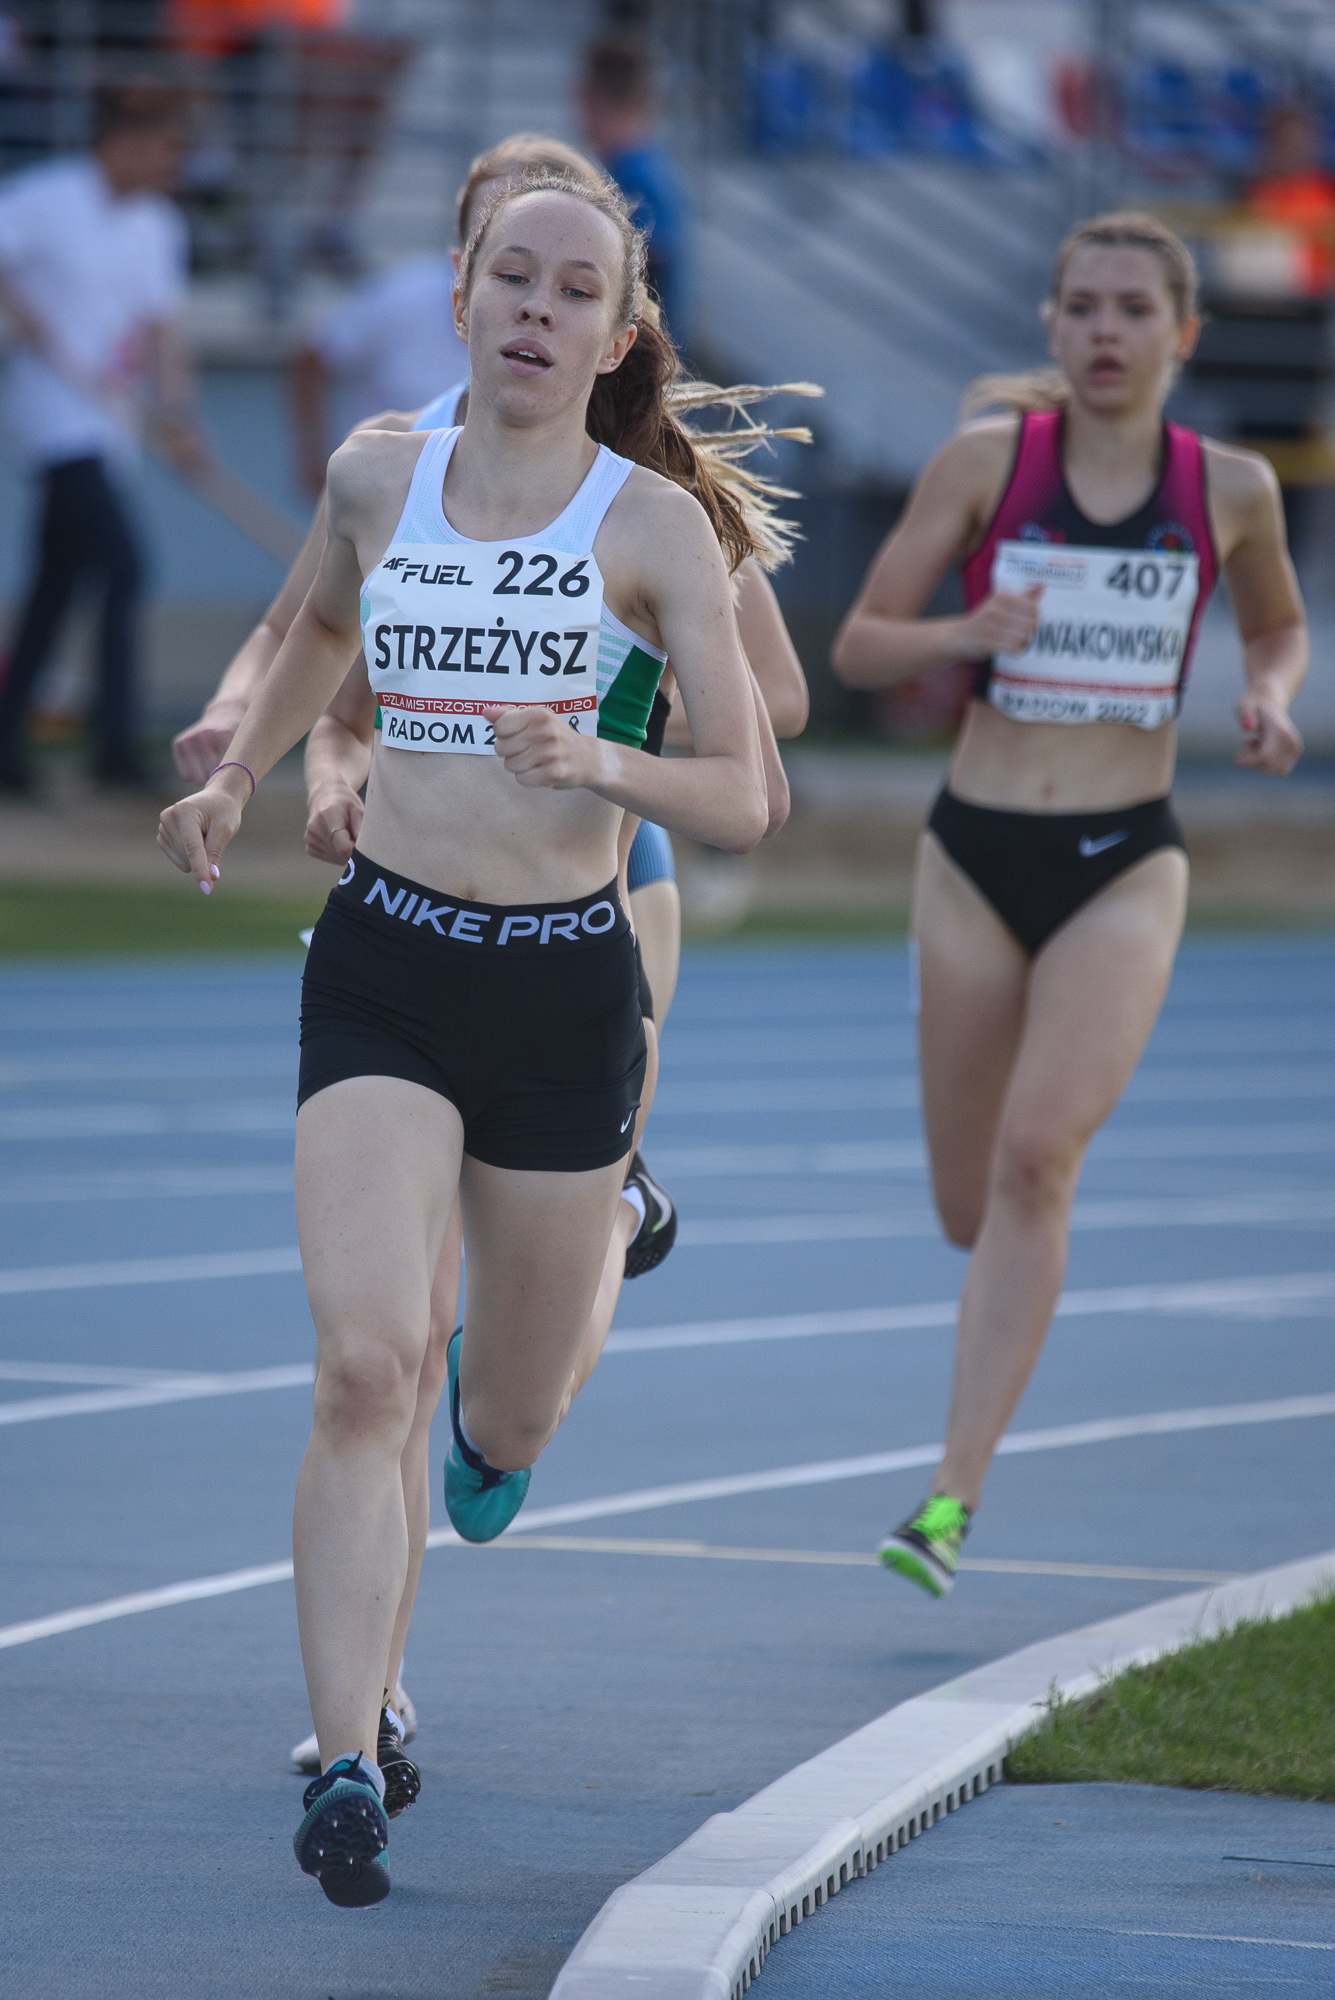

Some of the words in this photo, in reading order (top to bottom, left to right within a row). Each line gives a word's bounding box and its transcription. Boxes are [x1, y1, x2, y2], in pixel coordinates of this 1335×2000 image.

[401, 564, 474, 586] FUEL
[493, 550, 590, 598] 226
[1106, 560, 1187, 600] 407
[374, 616, 589, 676] STRZEŻYSZ
[1033, 621, 1183, 665] WAKOWSKA
[382, 694, 405, 707] PZLA
[562, 698, 593, 712] U20
[388, 716, 476, 745] RADOM
[363, 877, 492, 944] NIKE
[497, 900, 616, 946] PRO
